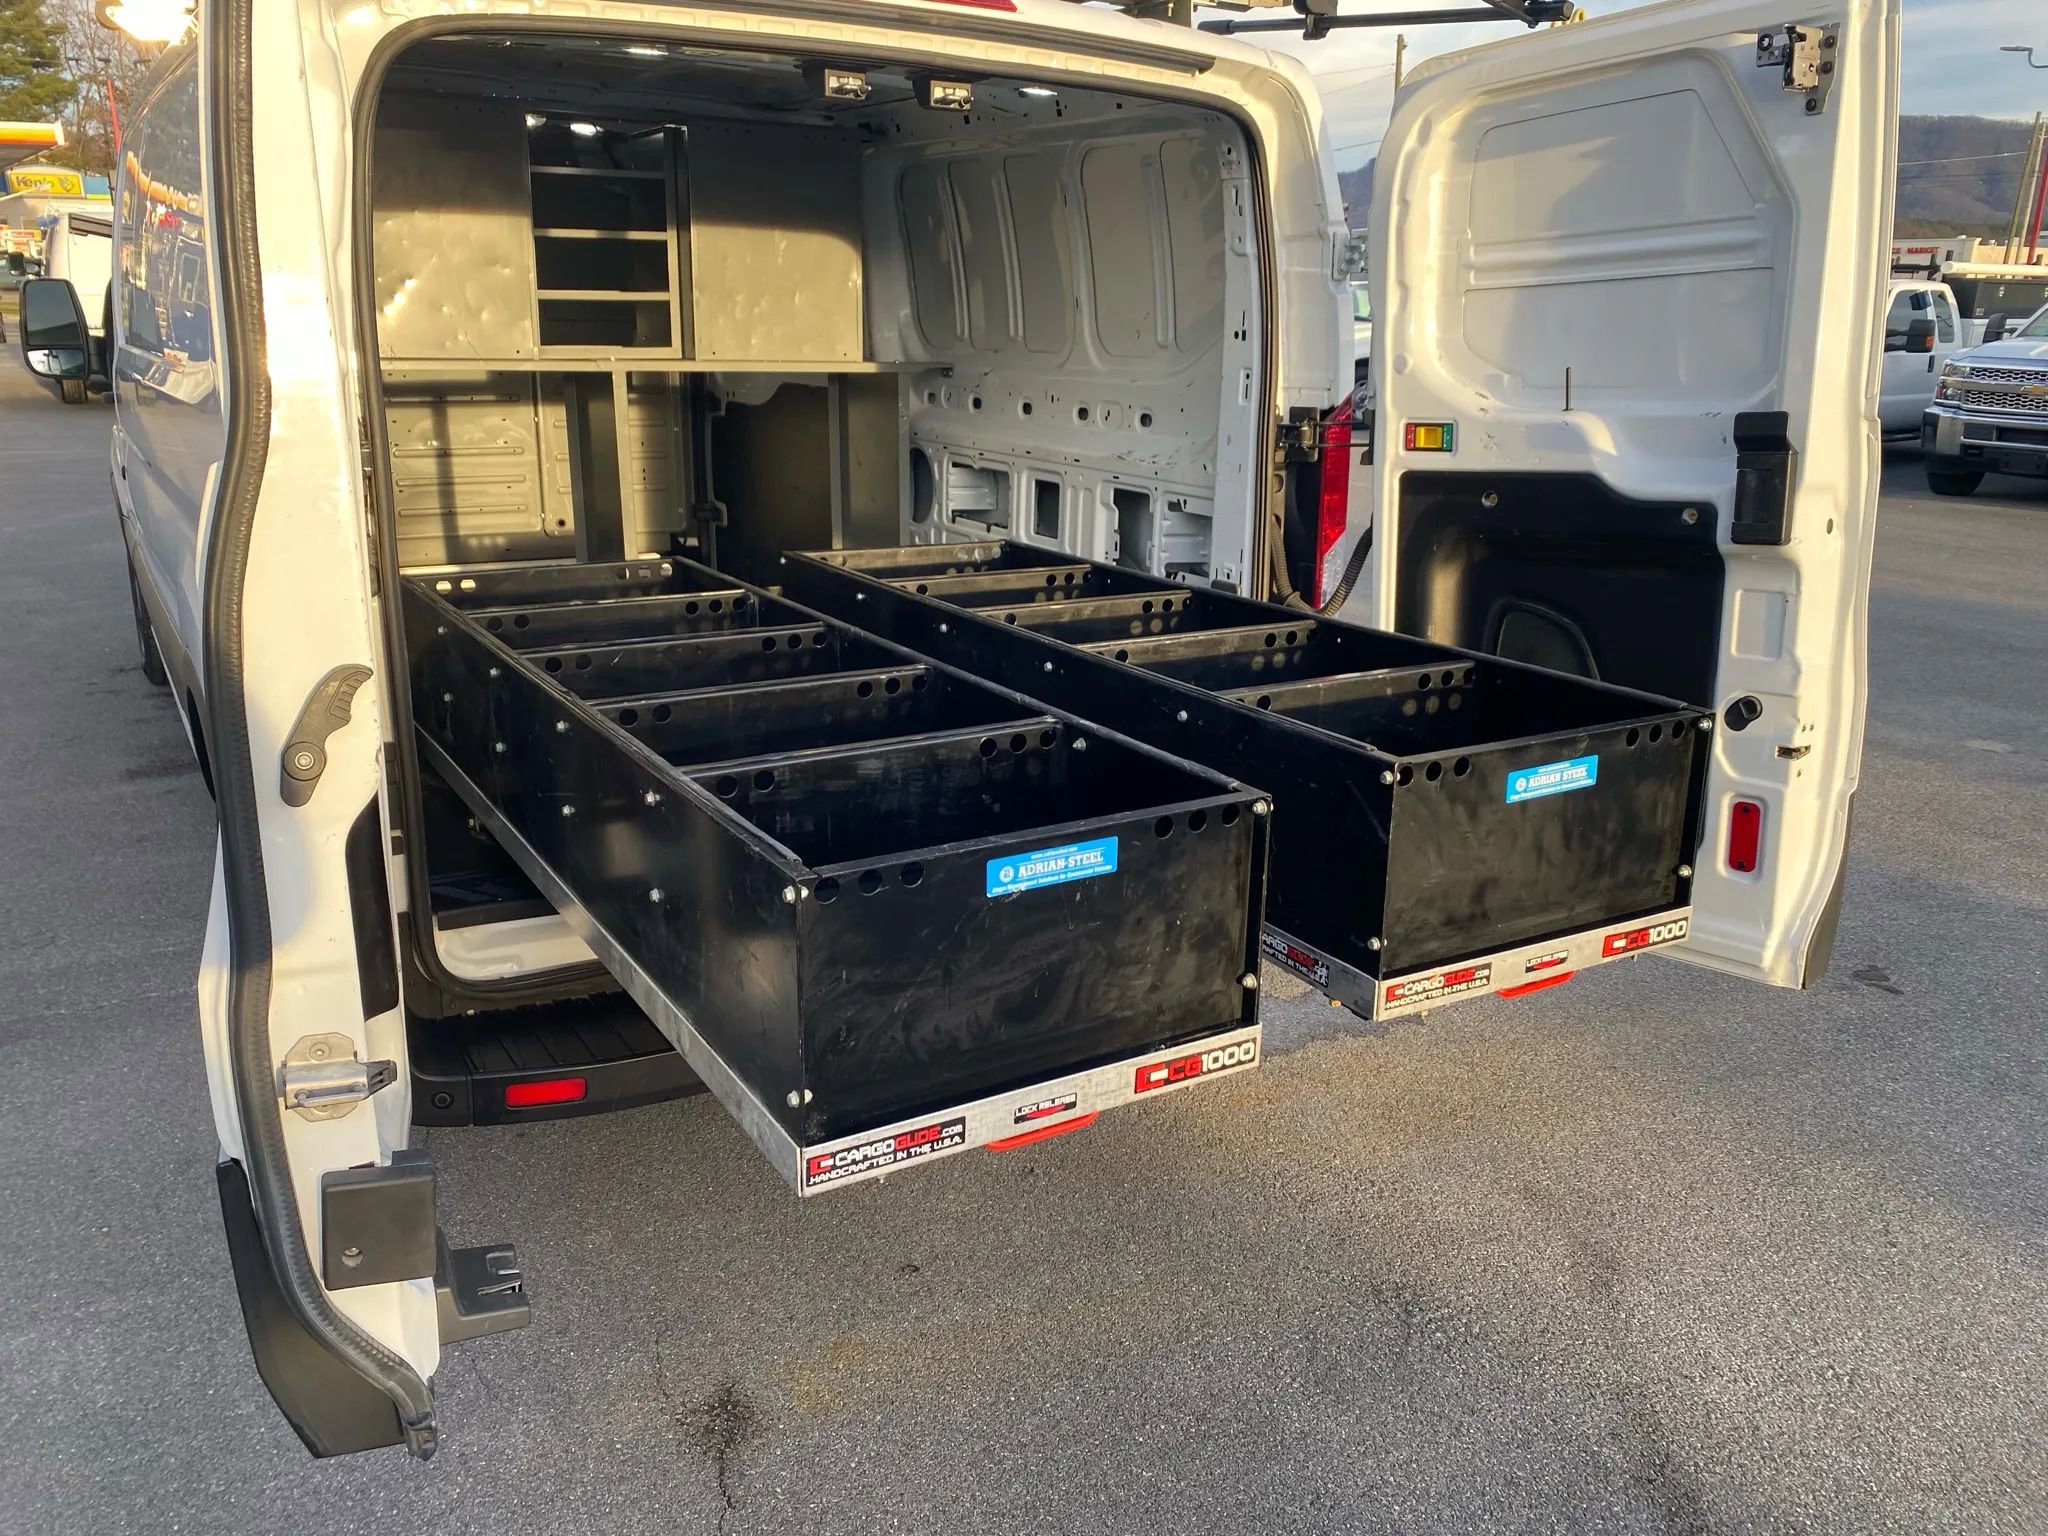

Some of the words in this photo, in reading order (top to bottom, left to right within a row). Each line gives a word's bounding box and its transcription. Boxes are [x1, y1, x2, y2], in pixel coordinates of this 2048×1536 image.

[15, 175, 56, 188] Keno
[1168, 1041, 1255, 1080] CG1000
[1016, 1104, 1039, 1117] LOCK
[809, 1154, 895, 1184] HANDCRAFTED
[896, 1149, 908, 1161] IN
[909, 1143, 932, 1157] THE
[933, 1135, 963, 1150] U.S.A.
